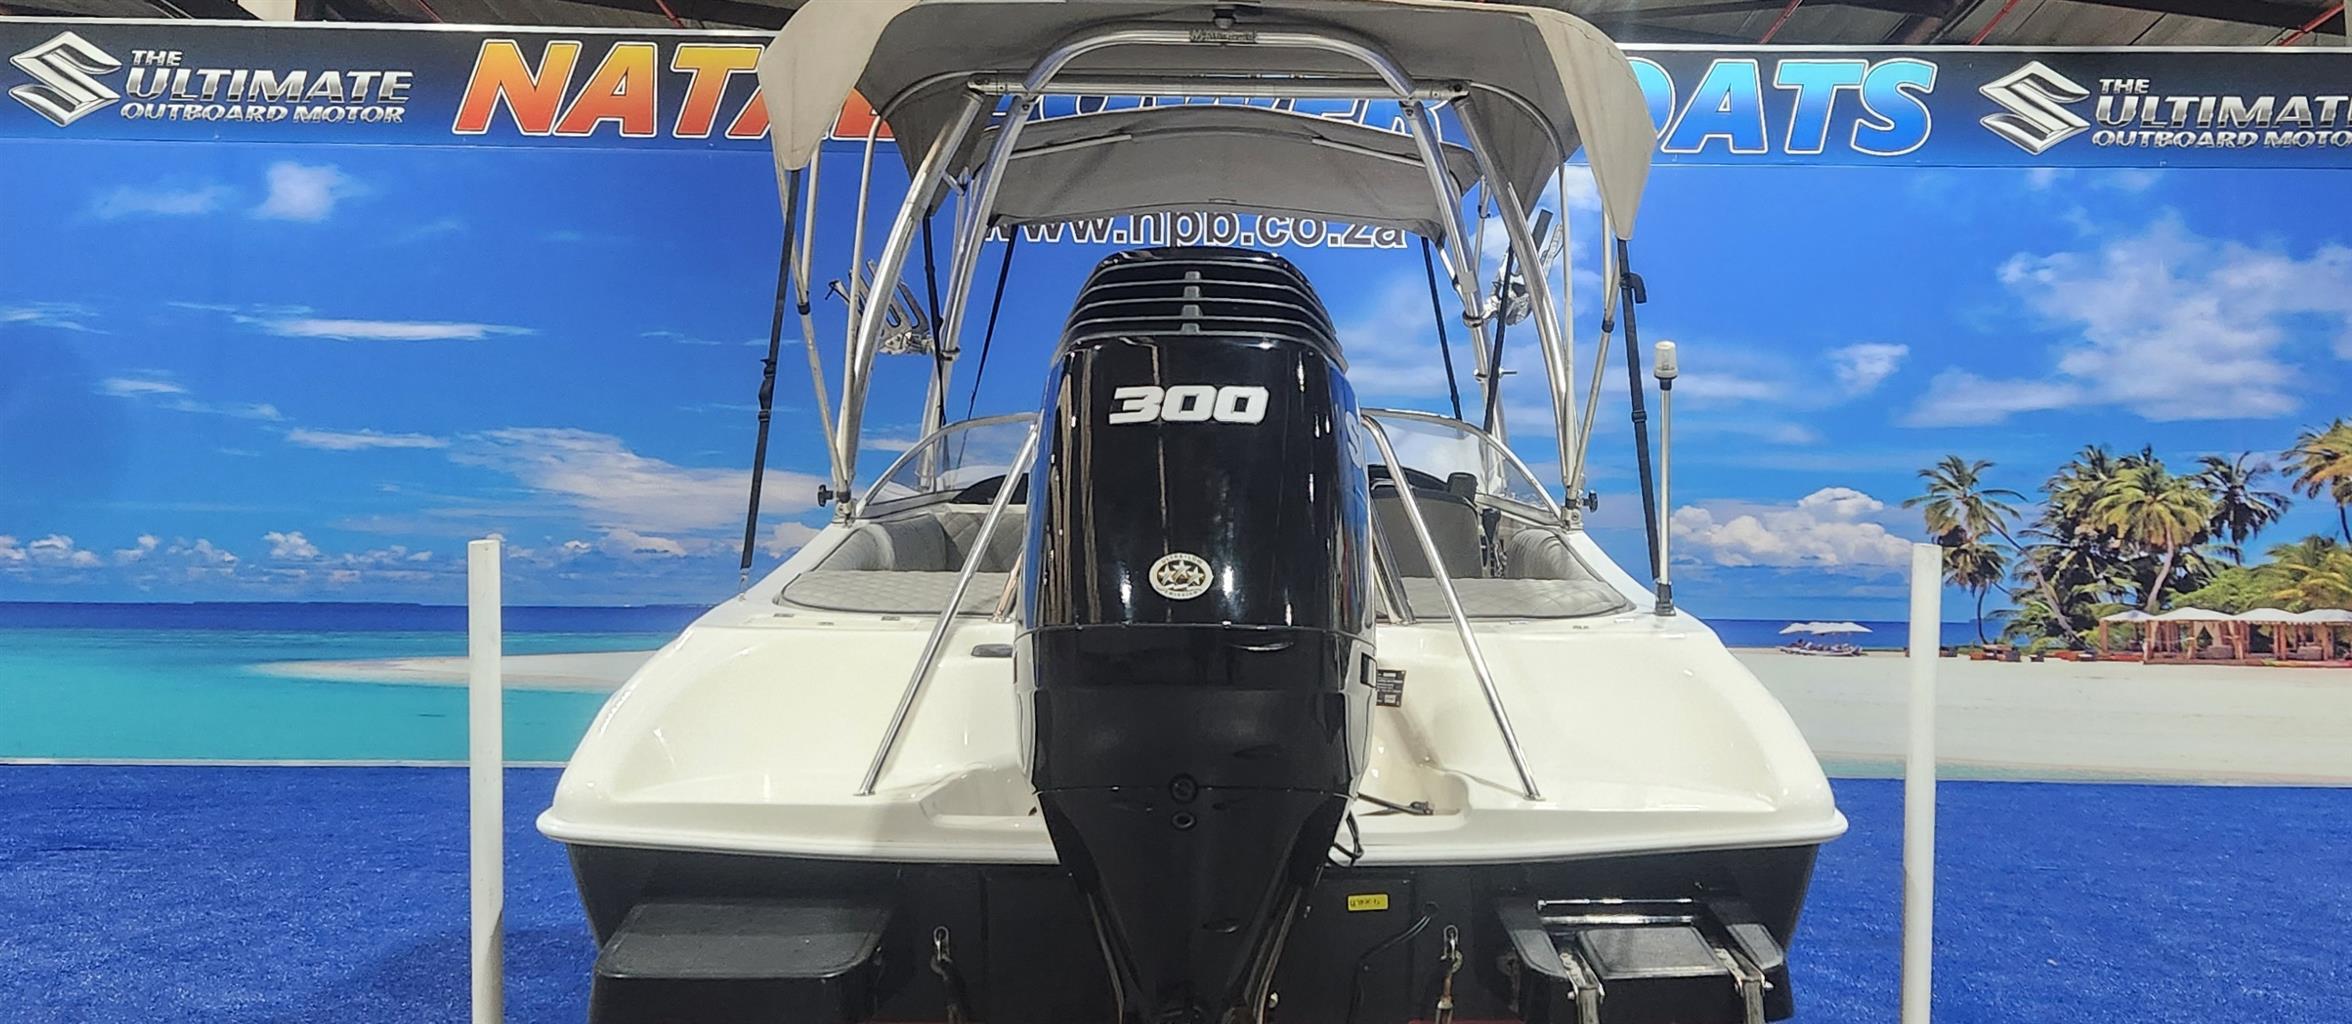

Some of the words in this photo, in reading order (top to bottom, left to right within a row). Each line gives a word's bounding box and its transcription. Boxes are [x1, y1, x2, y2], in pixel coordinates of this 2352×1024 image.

[131, 50, 183, 66] THE
[125, 67, 414, 102] ULTIMATE
[2099, 79, 2150, 94] THE
[121, 103, 288, 121] OUTBOARD
[294, 105, 405, 123] MOTOR
[2095, 96, 2352, 128] ULTIMAT
[2092, 130, 2258, 148] OUTBOARD
[1109, 385, 1269, 424] 300
